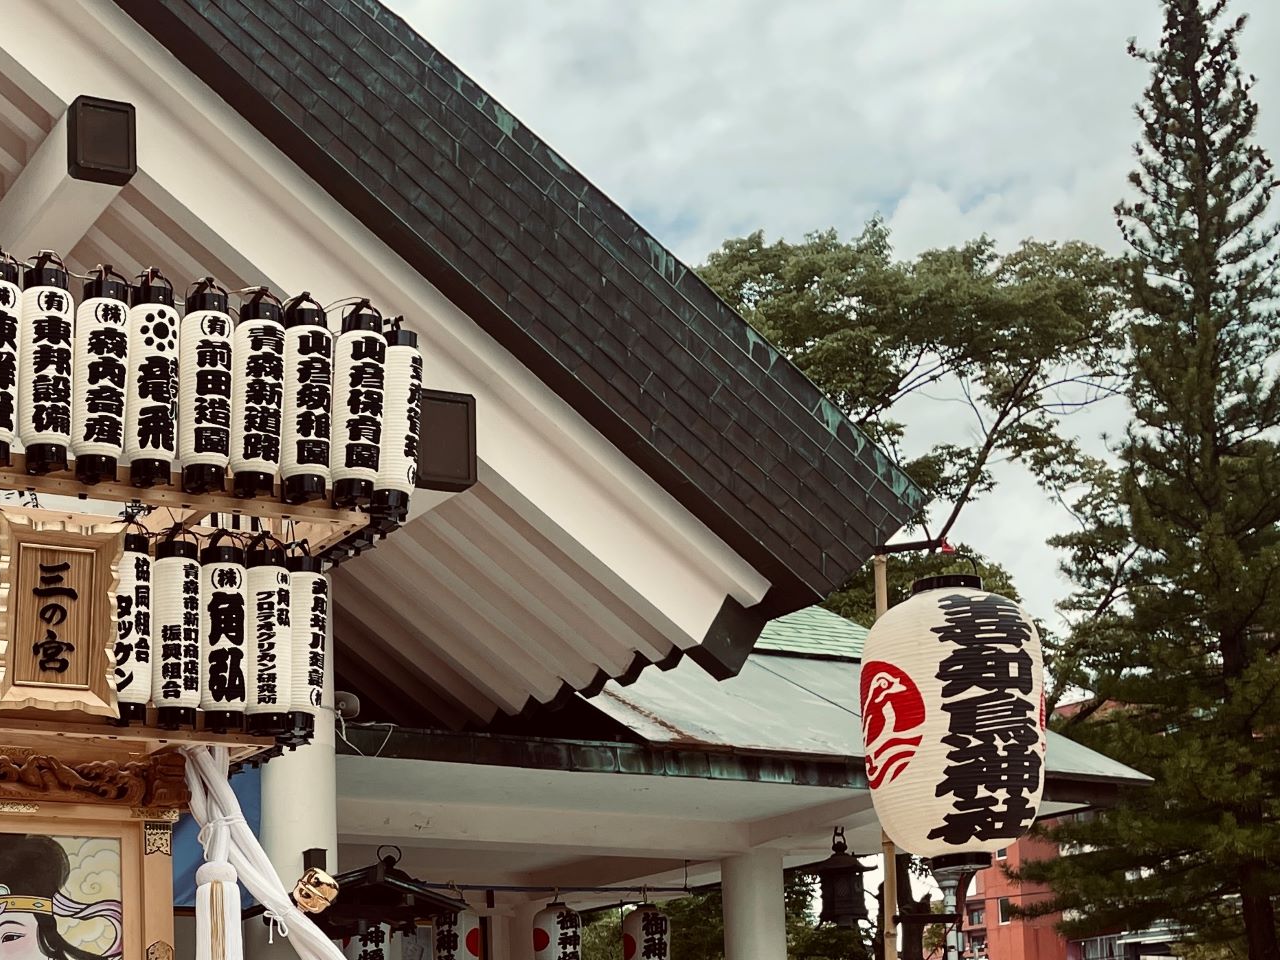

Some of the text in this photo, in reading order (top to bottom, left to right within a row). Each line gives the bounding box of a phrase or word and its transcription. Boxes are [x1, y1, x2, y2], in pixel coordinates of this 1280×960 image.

[32, 561, 78, 674] 三の宮
[927, 594, 1041, 845] 善知鳥神社
